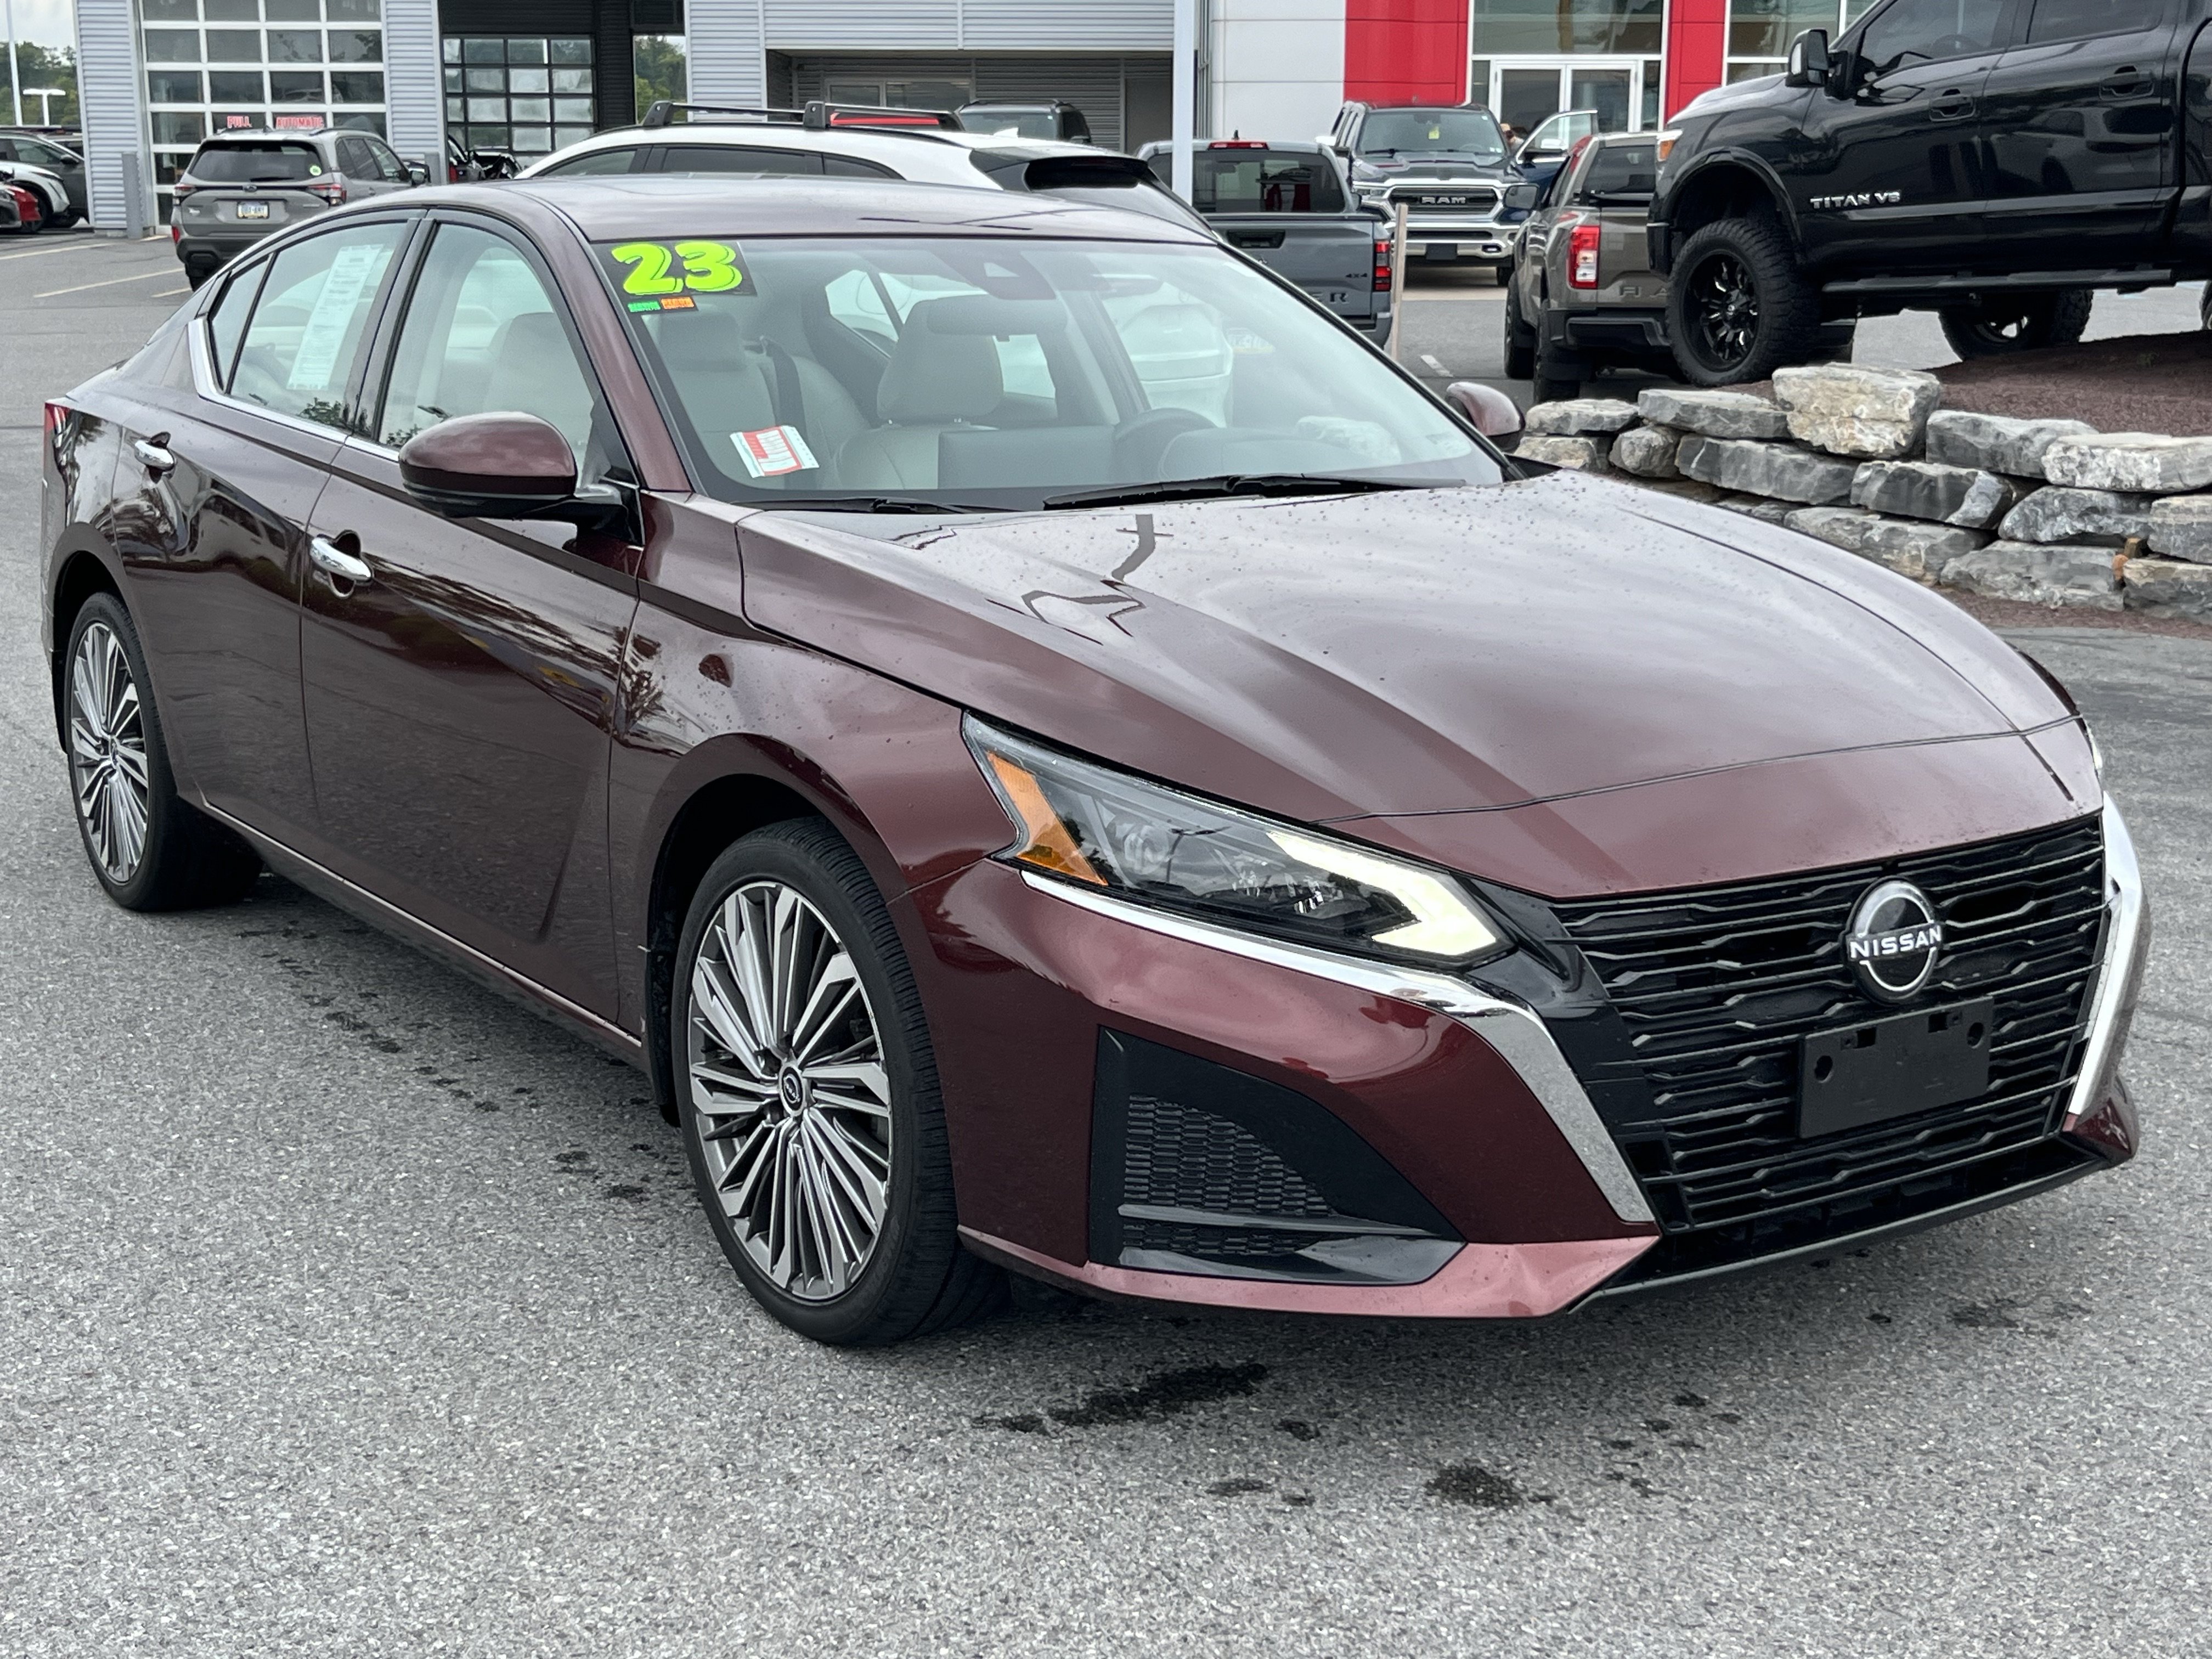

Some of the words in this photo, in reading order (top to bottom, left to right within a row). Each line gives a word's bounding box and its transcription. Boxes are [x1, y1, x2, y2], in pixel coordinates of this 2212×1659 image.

[1810, 194, 1870, 209] TITAN
[611, 240, 742, 295] 23
[1849, 925, 1942, 959] NISSAN
